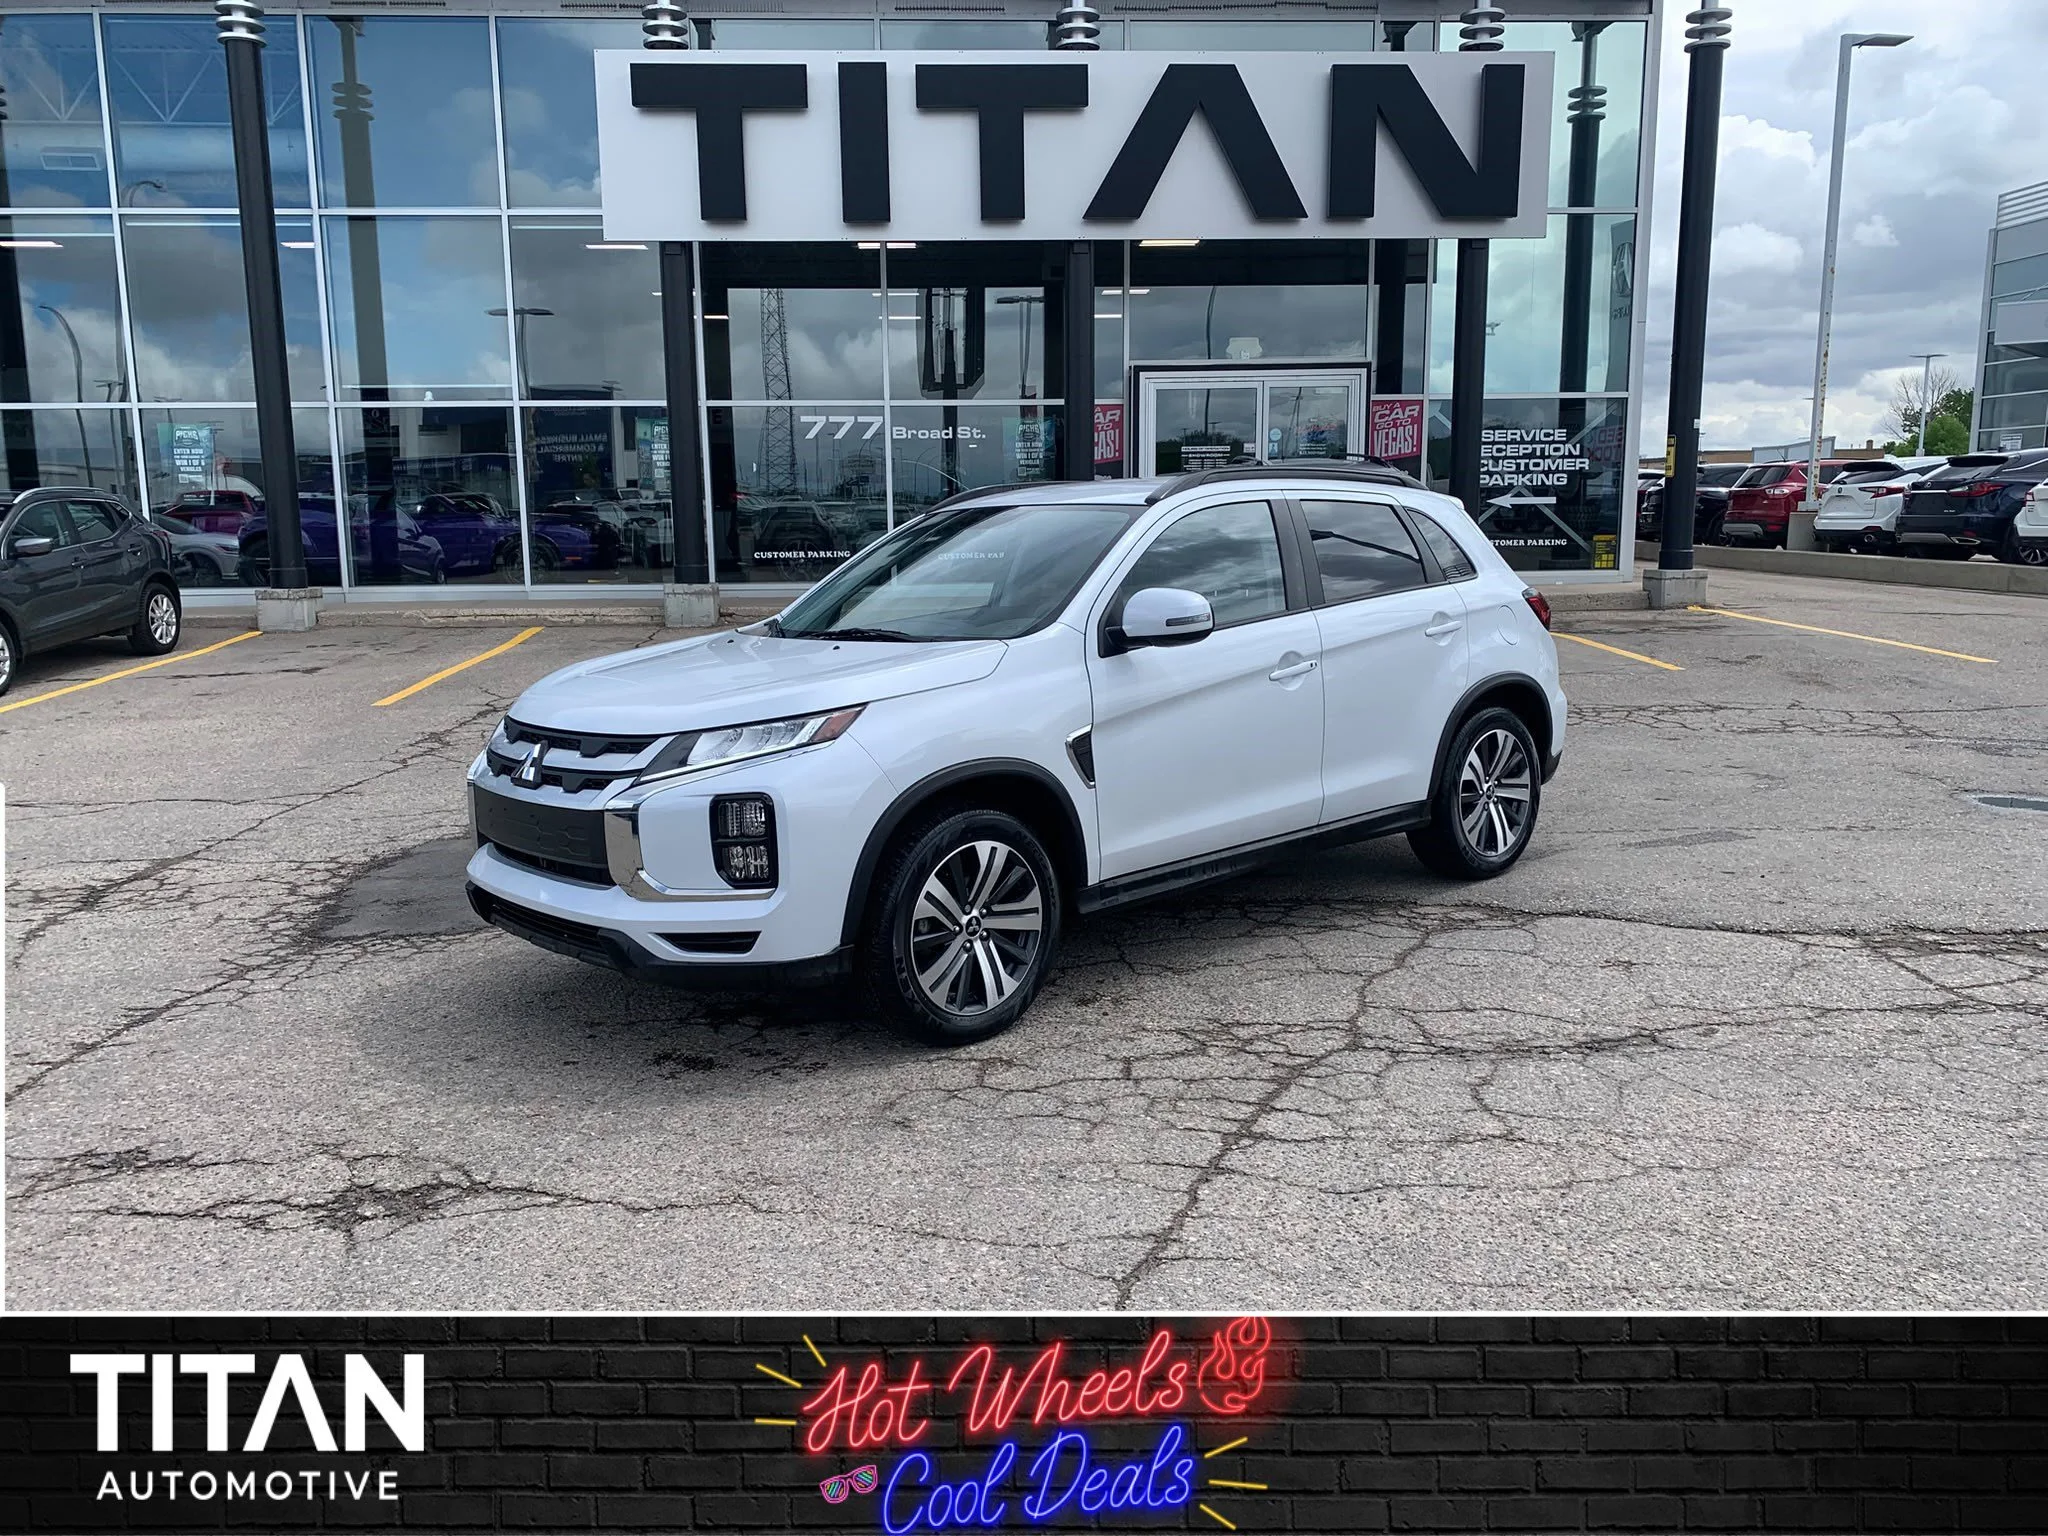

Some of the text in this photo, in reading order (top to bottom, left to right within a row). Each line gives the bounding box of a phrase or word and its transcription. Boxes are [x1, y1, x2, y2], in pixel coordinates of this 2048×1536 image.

[630, 62, 1525, 222] TITAN
[1094, 409, 1121, 424] AR
[1375, 405, 1419, 423] CAR
[800, 416, 986, 440] 777 Broad St.
[1096, 422, 1113, 431] TO
[1376, 418, 1411, 430] GO TO
[1374, 424, 1417, 457] VEGAS!
[1481, 429, 1567, 442] SERVICE
[1480, 443, 1580, 457] ECEPTION
[1480, 458, 1589, 472] CUSTOMER
[1480, 473, 1568, 486] PARKING
[754, 551, 806, 559] CUSTOMER
[938, 552, 985, 560] CUSTOMER
